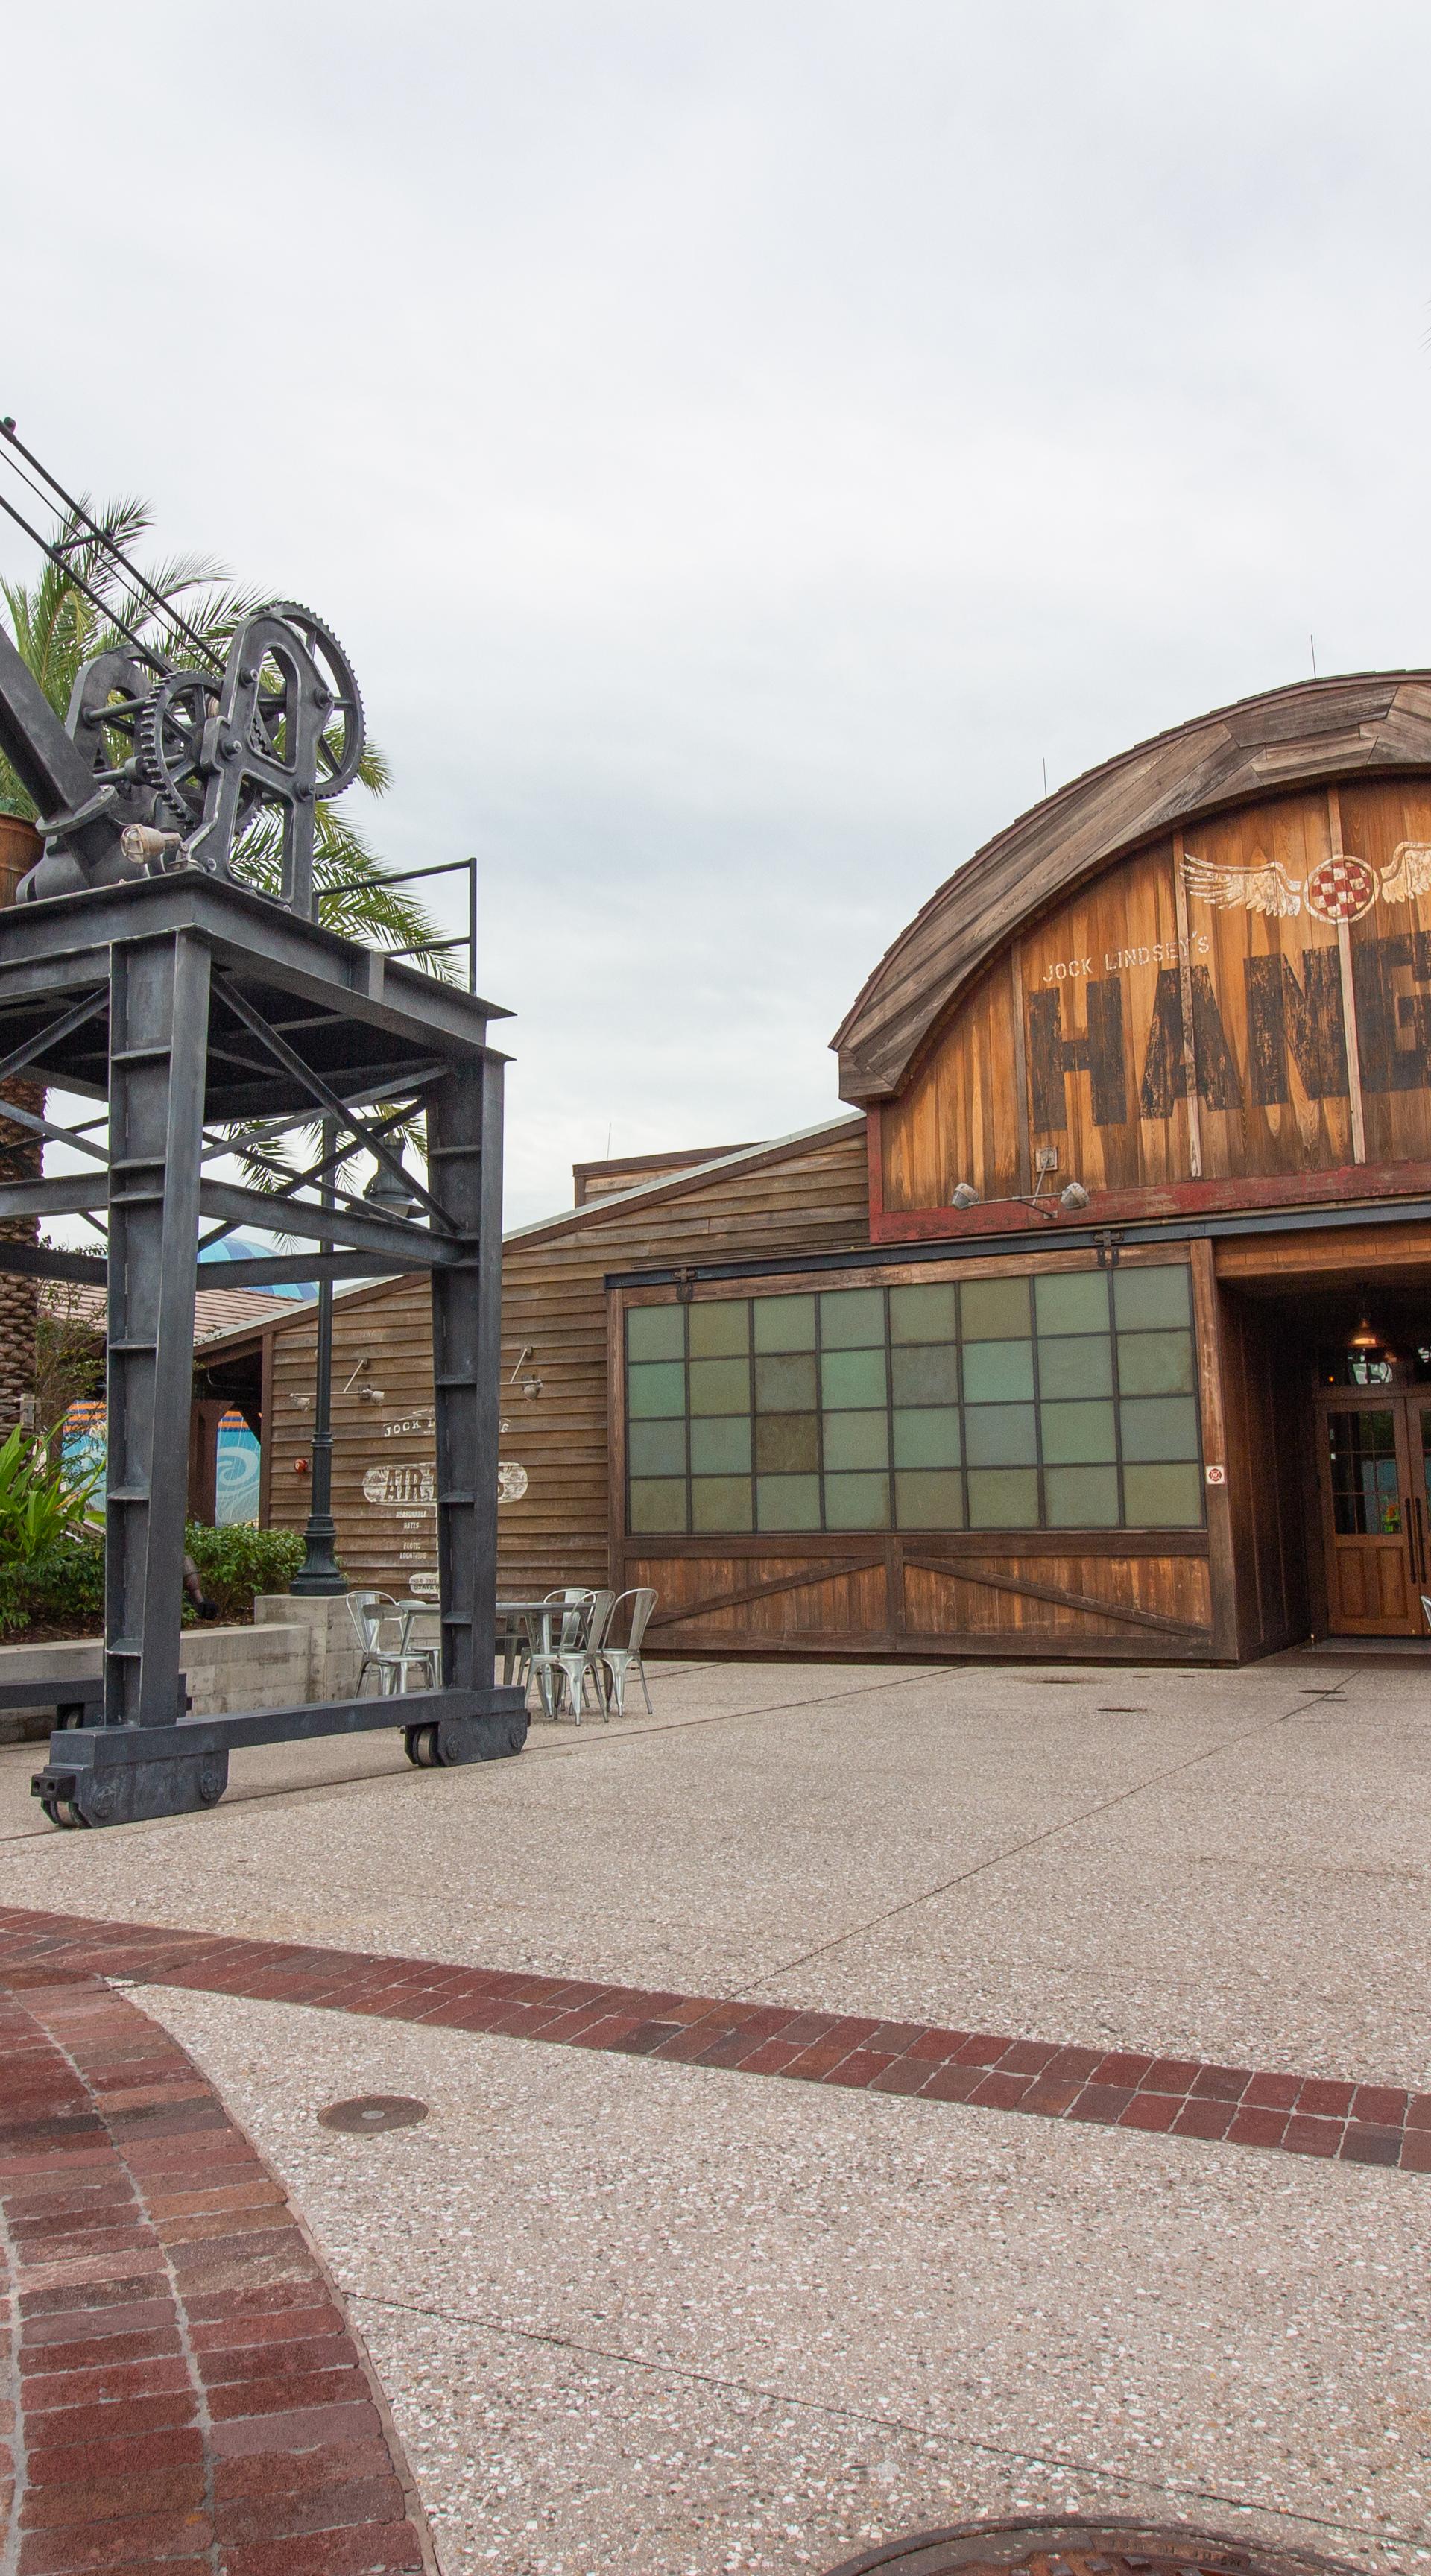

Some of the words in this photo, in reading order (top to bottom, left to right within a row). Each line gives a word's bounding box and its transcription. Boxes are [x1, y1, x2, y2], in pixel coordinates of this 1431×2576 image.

[1043, 957, 1093, 982] JOCK
[1105, 931, 1209, 971] LINDSEY'S
[384, 1419, 421, 1437] JOCK
[384, 1468, 423, 1500] AIR
